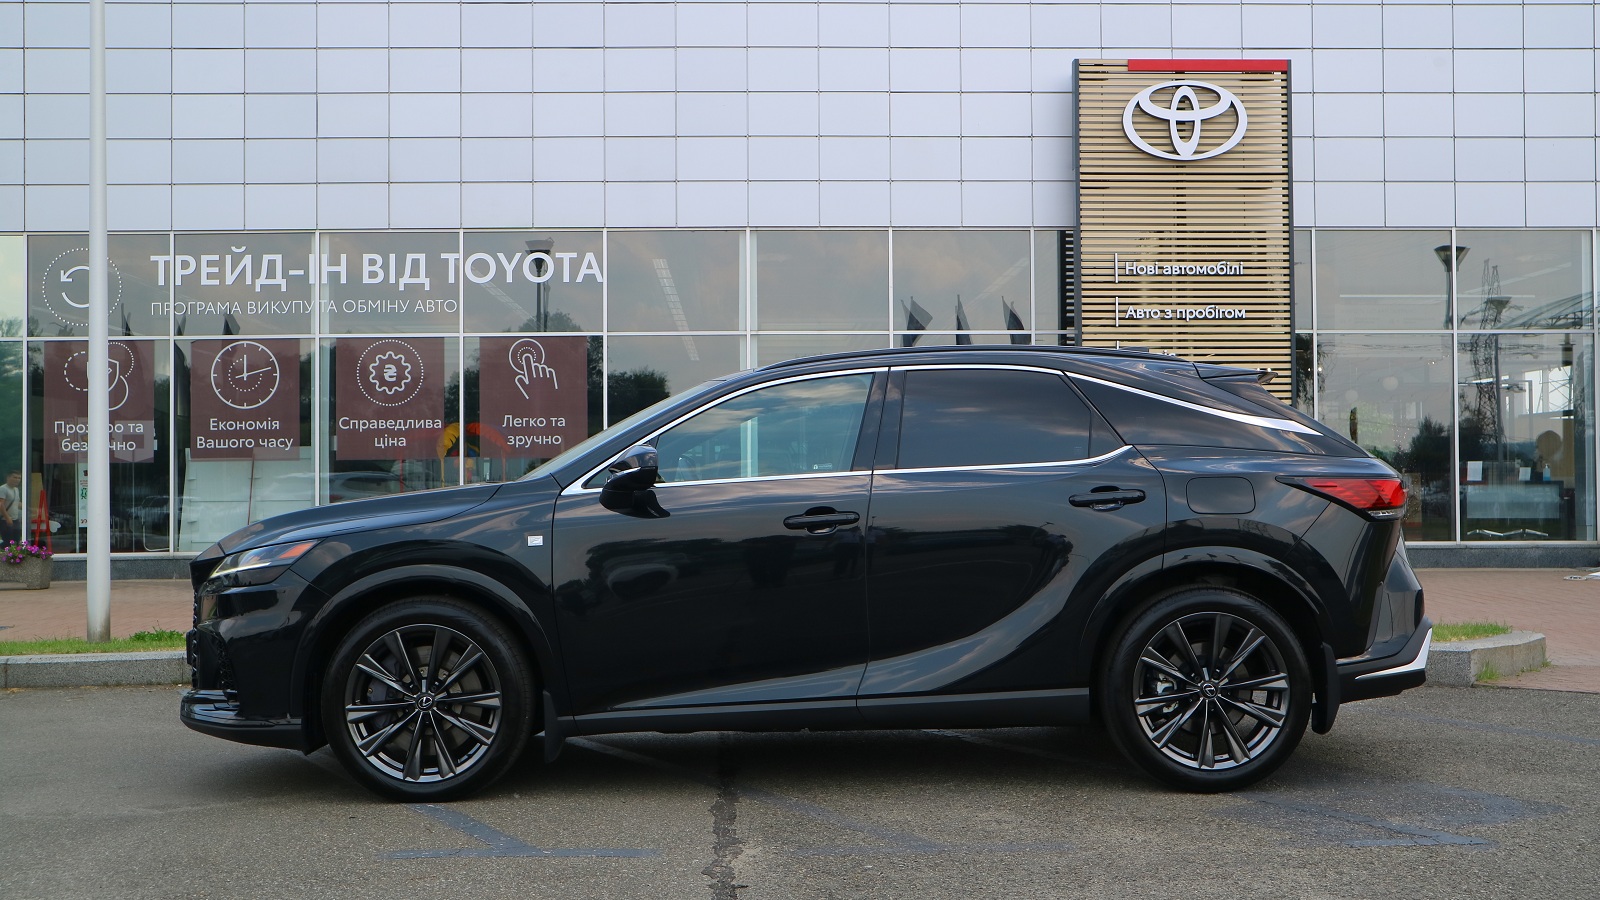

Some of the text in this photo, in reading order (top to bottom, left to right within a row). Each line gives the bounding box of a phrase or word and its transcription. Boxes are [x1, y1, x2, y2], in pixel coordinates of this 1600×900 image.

[150, 246, 603, 292] ТРЕЙД-ІН ВІД TOYOTA
[1125, 261, 1243, 275] Нові автомобілі
[151, 299, 458, 316] ПРОГРАМА ВИКУПУ ТА ОБМІНУ АВТО
[1125, 305, 1246, 322] Авто з пробігом
[127, 423, 144, 433] та
[209, 418, 280, 431] Економія
[338, 416, 442, 431] Справедлива
[502, 415, 566, 428] Легко та
[61, 438, 136, 451] безчно
[196, 436, 293, 451] Вашого часу
[374, 434, 407, 448] ціна
[507, 434, 562, 448] зручно
